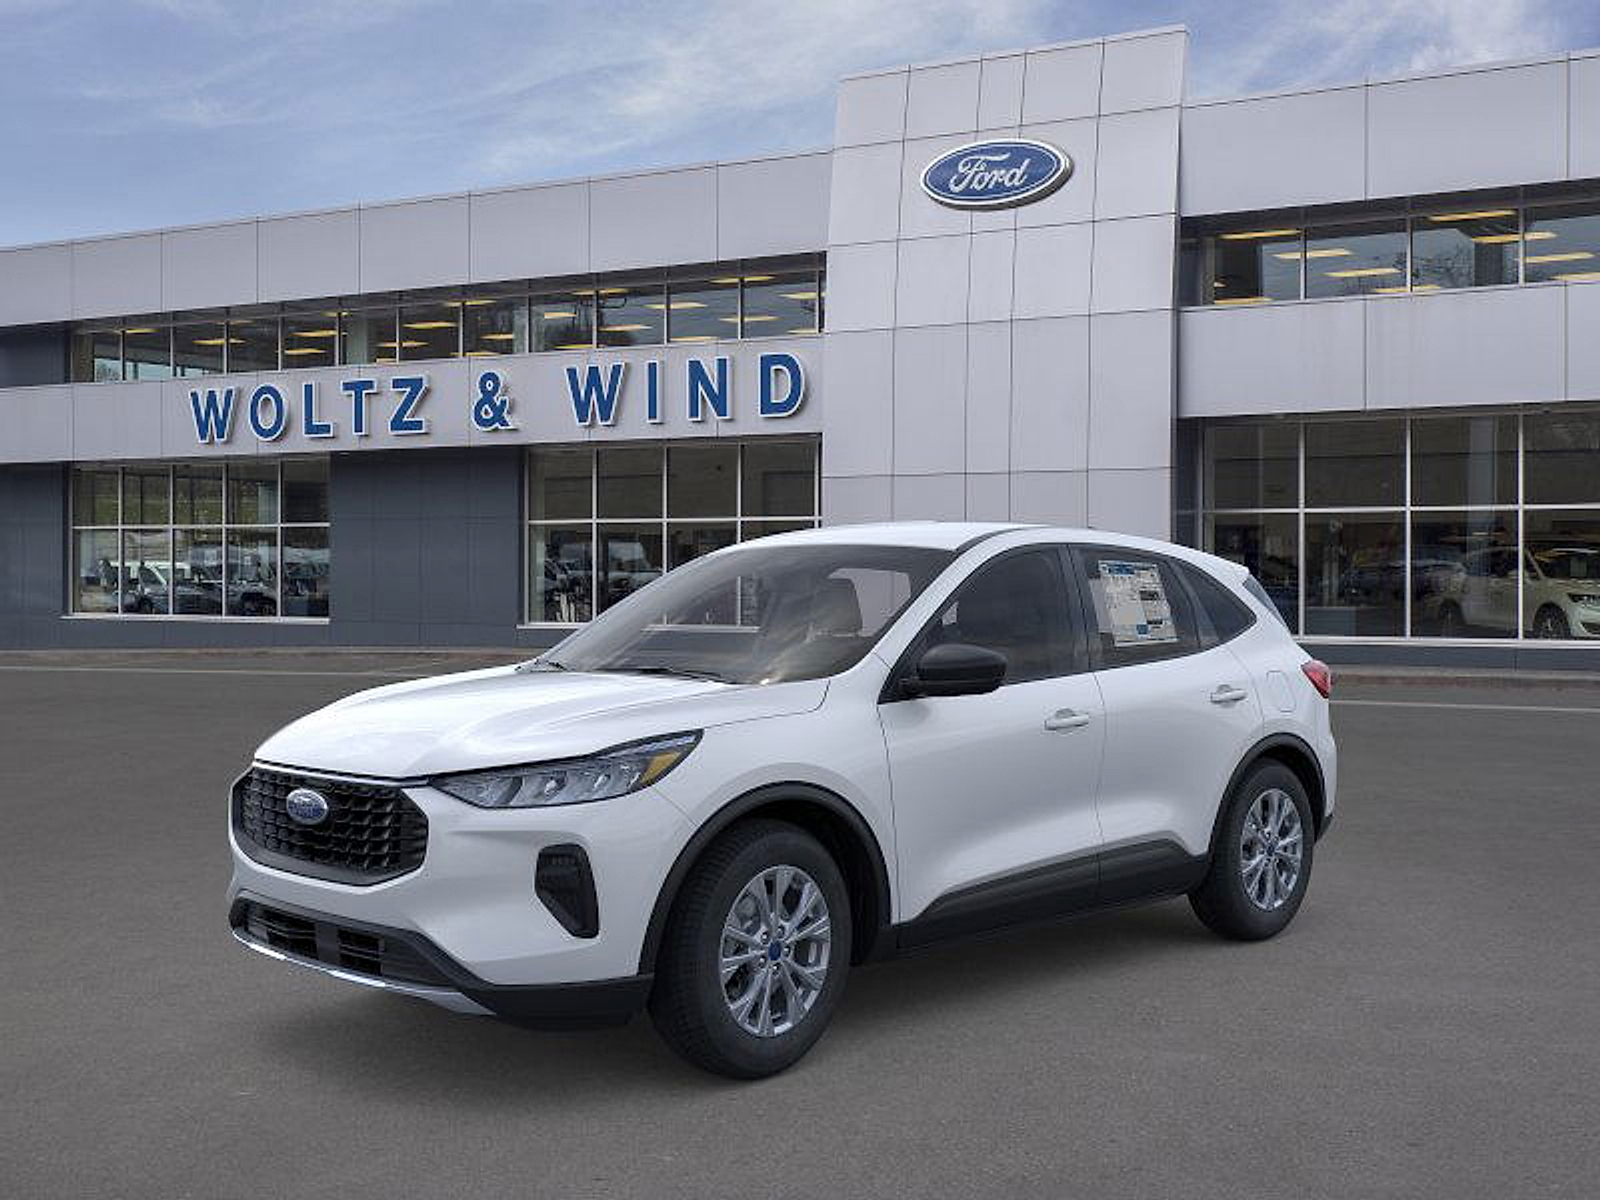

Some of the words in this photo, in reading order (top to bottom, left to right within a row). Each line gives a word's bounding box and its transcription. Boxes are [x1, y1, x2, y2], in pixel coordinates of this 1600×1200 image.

[949, 152, 1031, 193] Ford
[189, 376, 428, 443] WOLTZ
[472, 370, 512, 430] &
[566, 352, 805, 426] WIND
